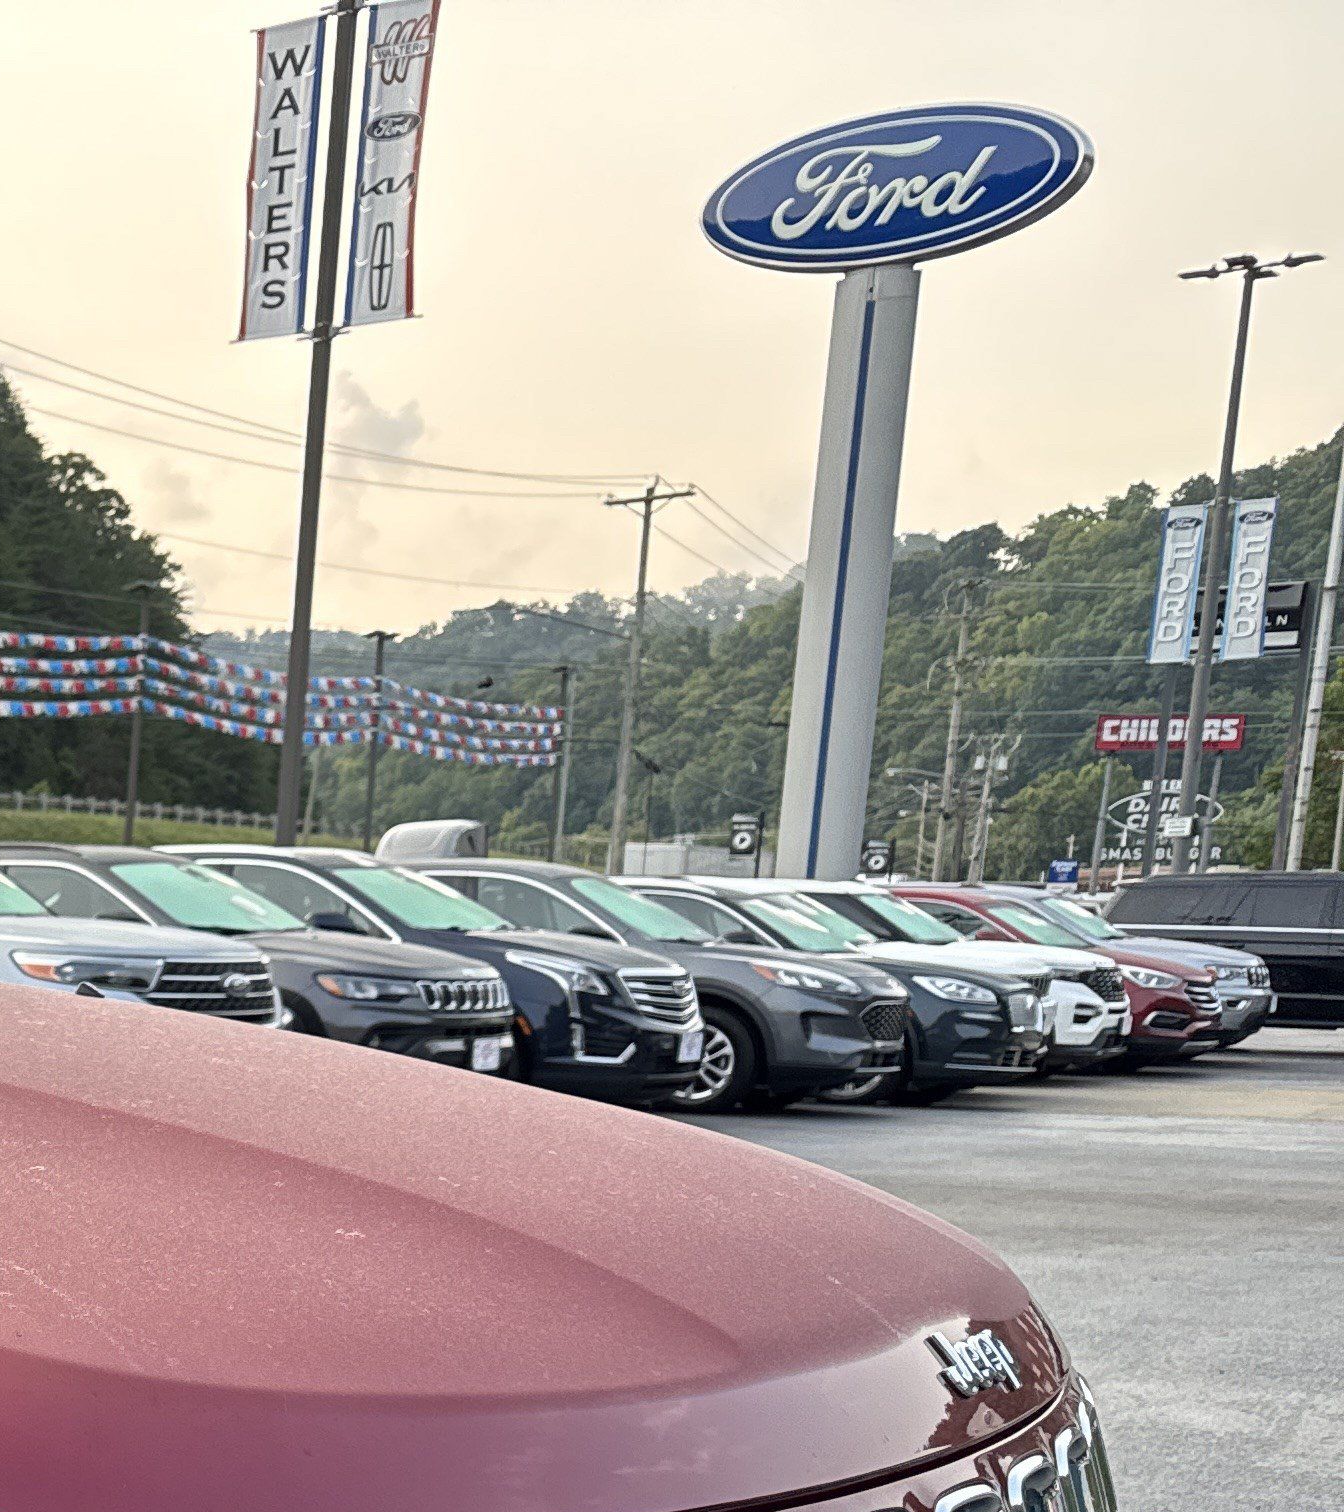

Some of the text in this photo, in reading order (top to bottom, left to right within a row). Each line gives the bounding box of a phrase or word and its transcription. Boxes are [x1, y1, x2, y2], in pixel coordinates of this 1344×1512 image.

[260, 44, 311, 310] WALTERS
[770, 134, 998, 241] Ford
[1156, 541, 1196, 643] FORD
[1232, 535, 1269, 638] FORD
[923, 1329, 1023, 1398] Jeep
